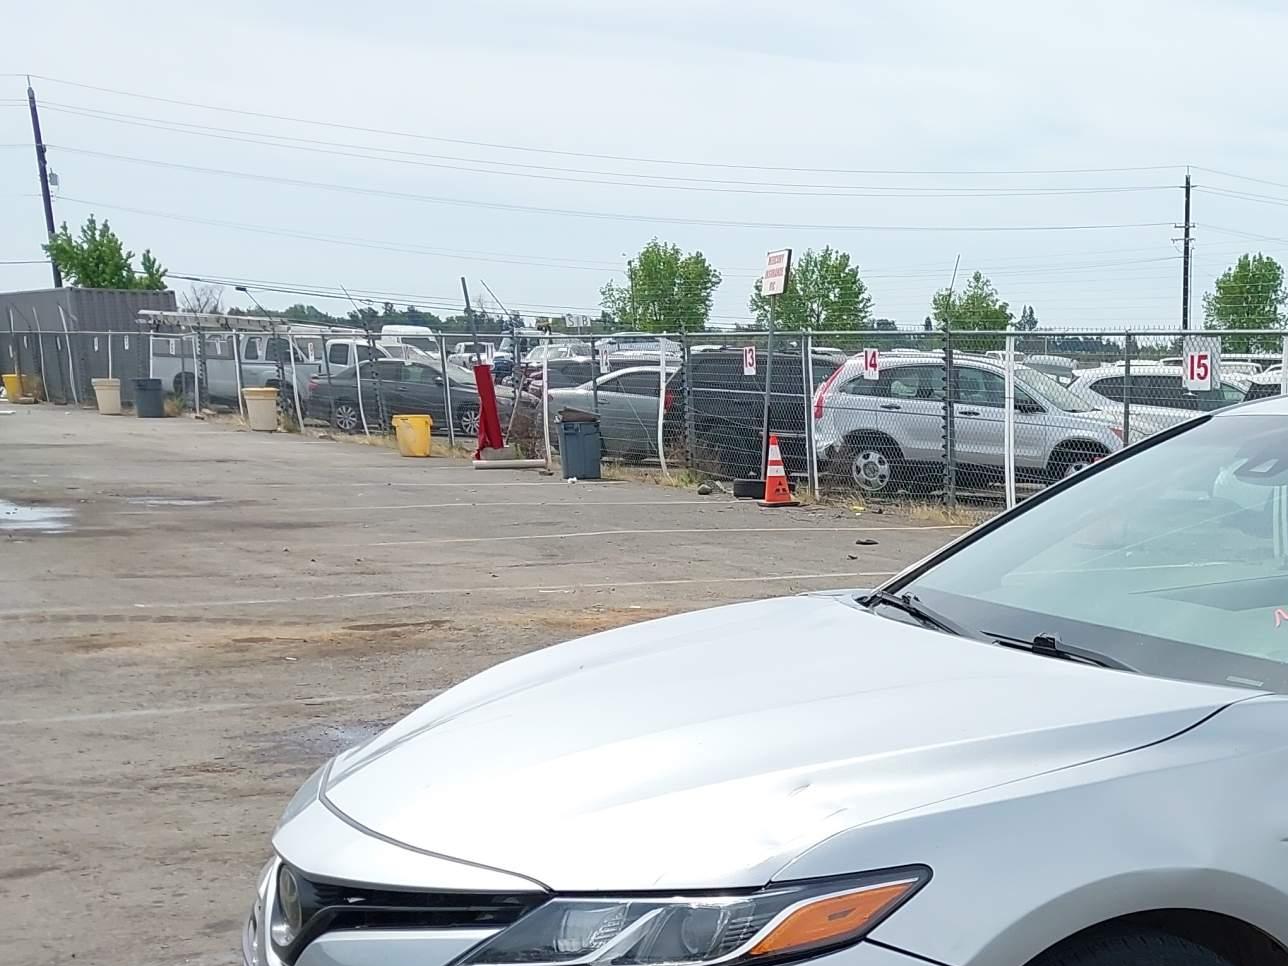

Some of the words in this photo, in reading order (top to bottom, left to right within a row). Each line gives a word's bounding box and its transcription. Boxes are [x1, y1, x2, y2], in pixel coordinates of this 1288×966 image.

[744, 348, 755, 368] 13
[864, 350, 878, 371] 14
[1190, 354, 1208, 381] 15
